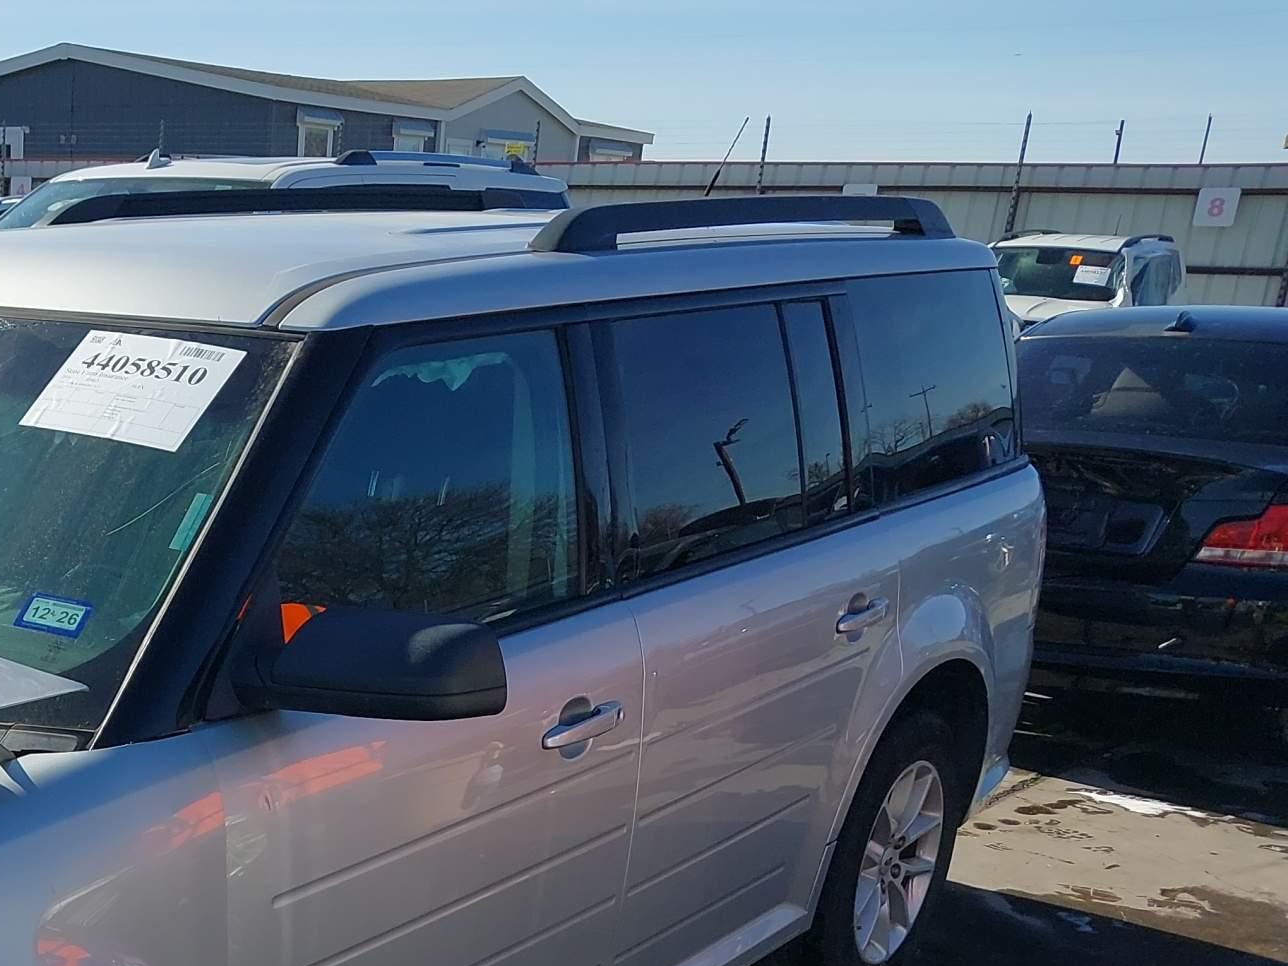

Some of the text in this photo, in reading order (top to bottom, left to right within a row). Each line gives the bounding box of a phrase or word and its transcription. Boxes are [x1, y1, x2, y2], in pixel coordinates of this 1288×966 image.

[1208, 197, 1225, 217] 8
[82, 352, 208, 386] 44058510
[56, 611, 80, 626] 26
